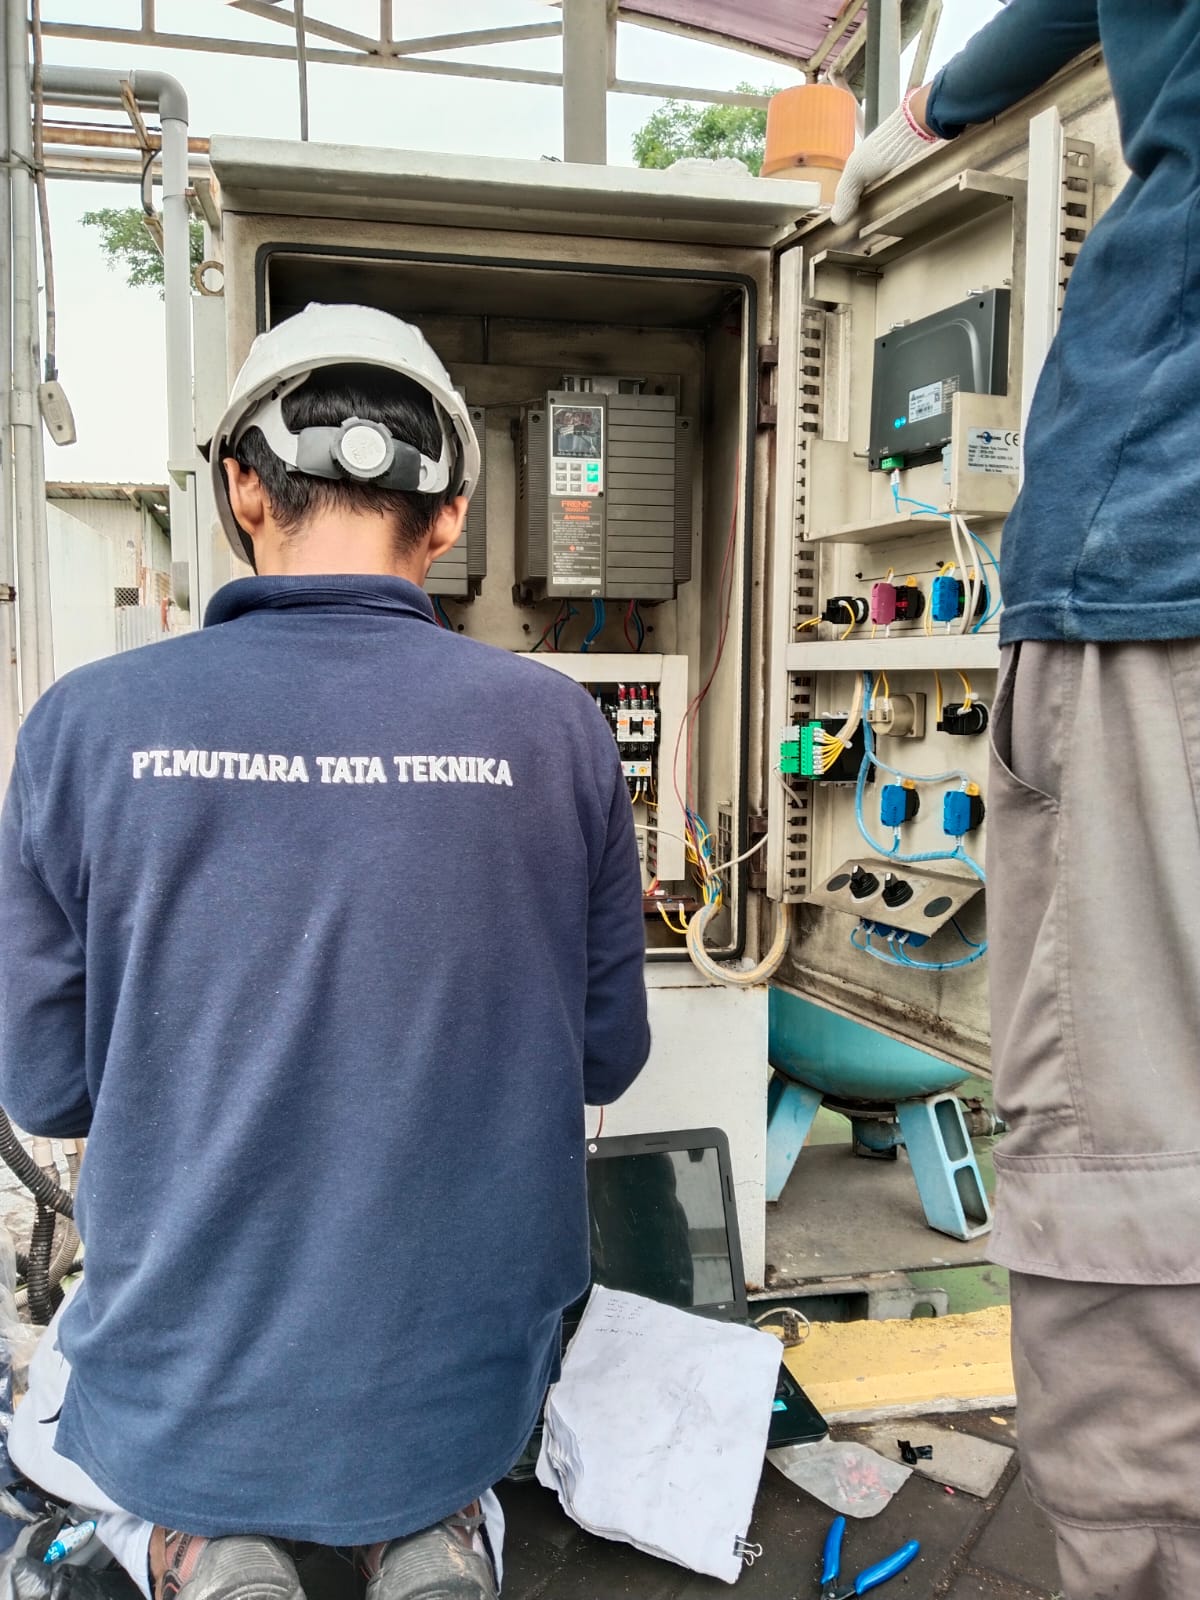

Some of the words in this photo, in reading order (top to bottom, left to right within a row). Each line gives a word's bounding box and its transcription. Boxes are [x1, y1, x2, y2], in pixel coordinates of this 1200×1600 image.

[132, 750, 309, 783] PT.MUTIARA
[316, 756, 387, 783] TATA
[393, 755, 513, 786] TEKNIKA
